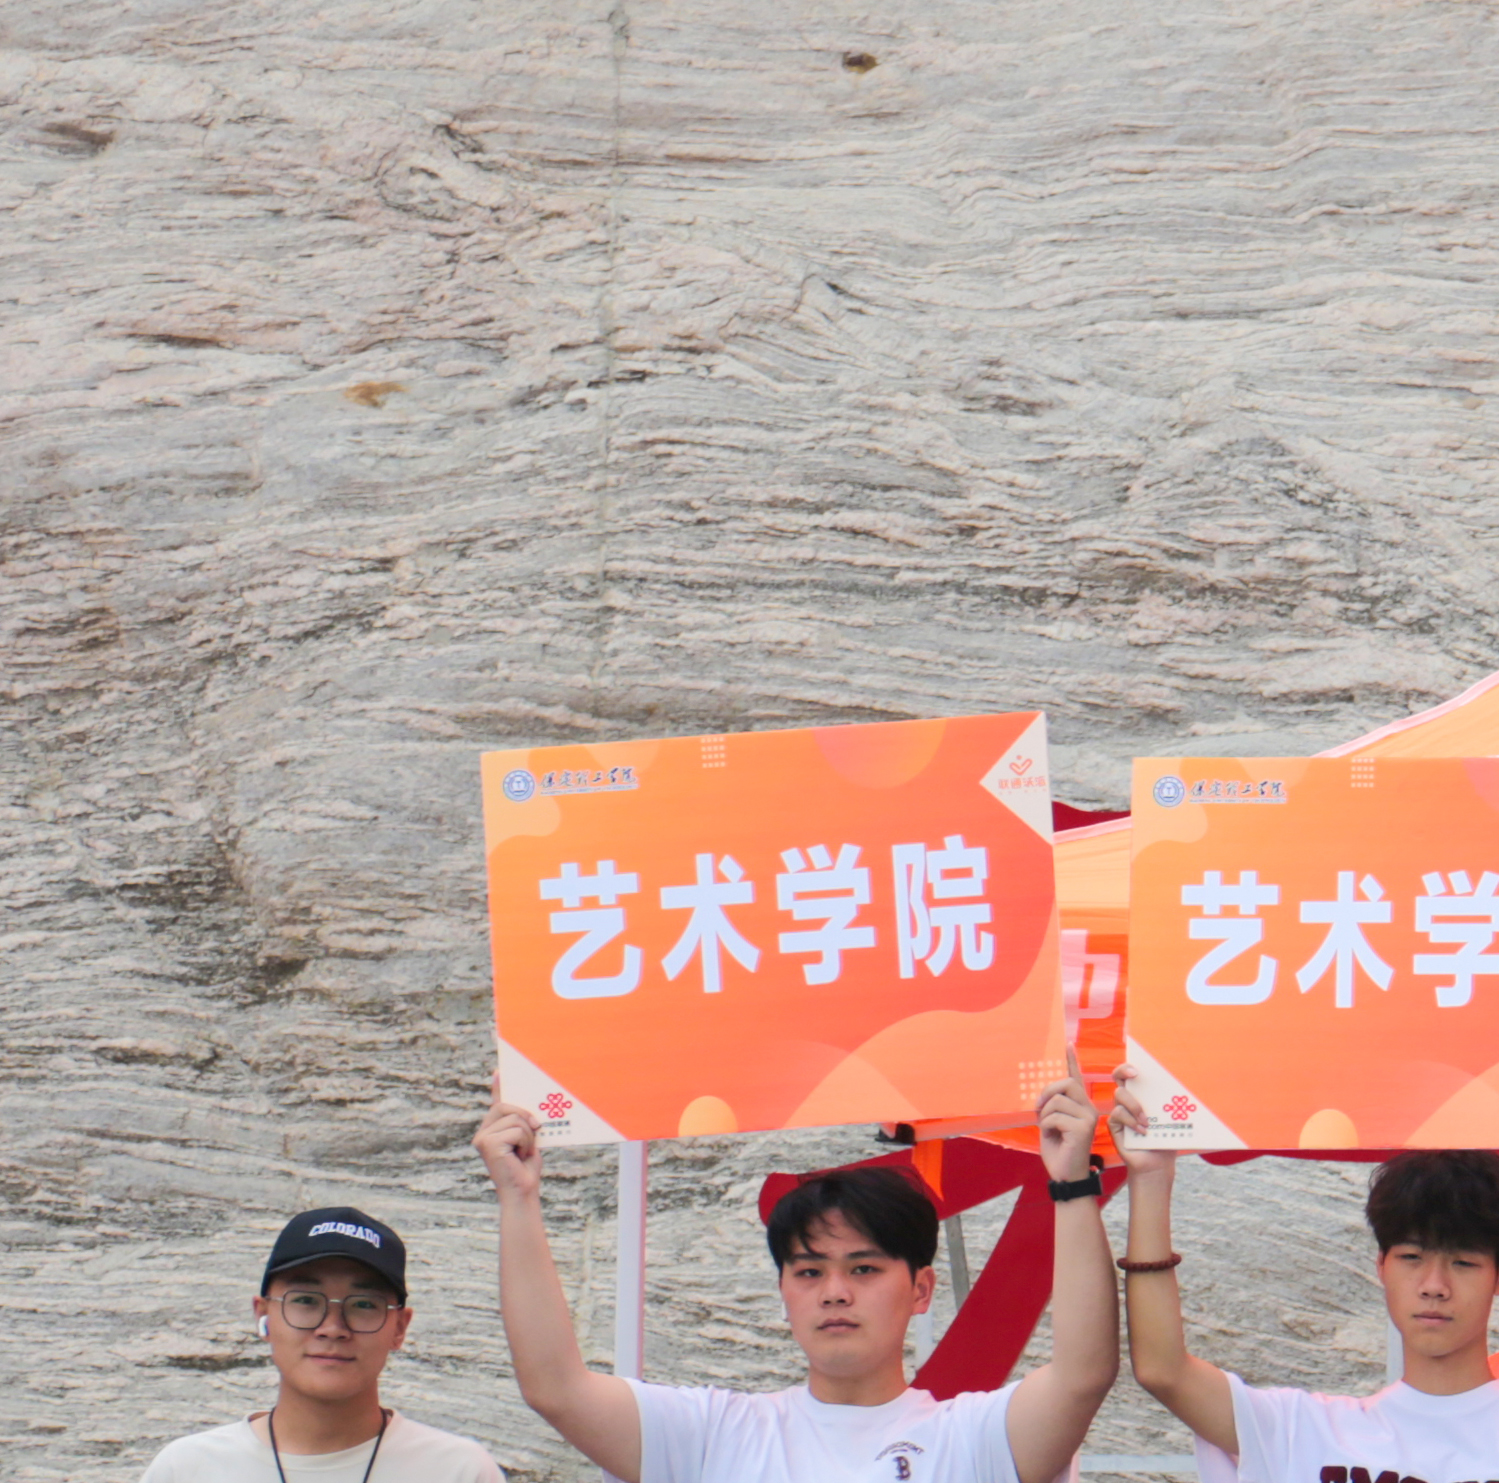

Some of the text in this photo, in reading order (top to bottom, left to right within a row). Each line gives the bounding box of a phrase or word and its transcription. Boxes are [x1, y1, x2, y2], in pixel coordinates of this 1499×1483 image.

[539, 834, 996, 1000] 艺术学院
[309, 1221, 380, 1249] COLORADO
